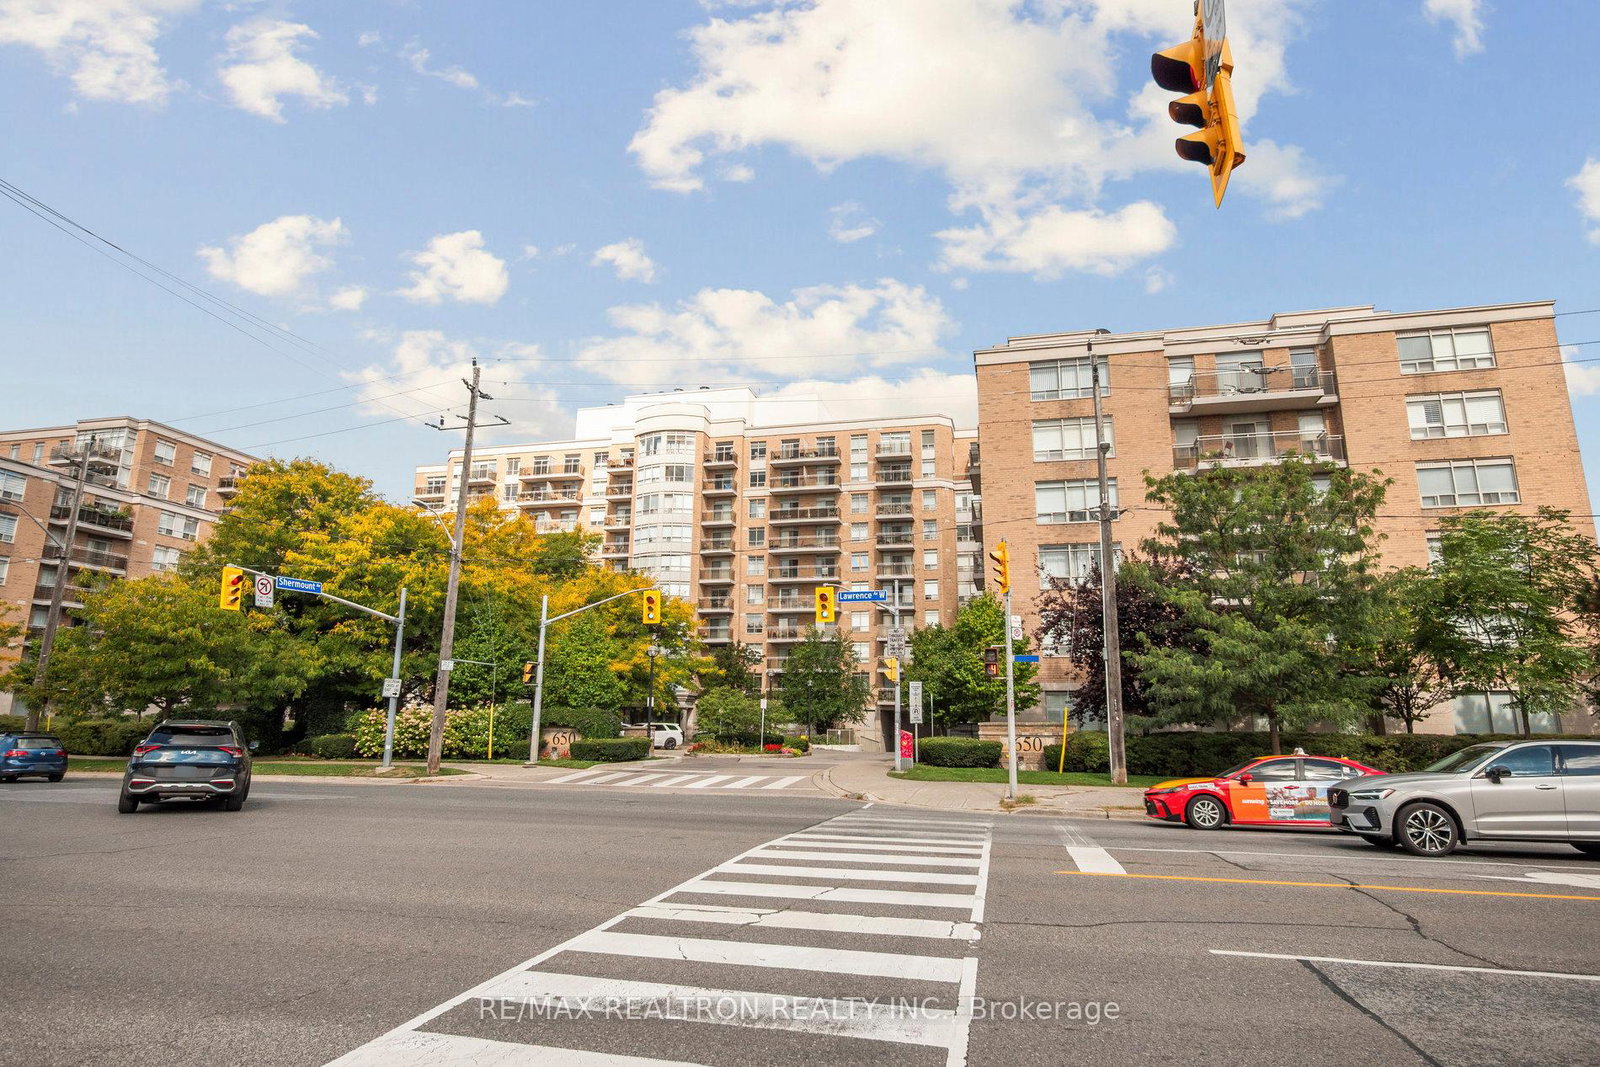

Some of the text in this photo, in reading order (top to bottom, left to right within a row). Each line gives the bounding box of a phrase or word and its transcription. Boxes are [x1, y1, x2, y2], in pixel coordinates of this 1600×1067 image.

[279, 577, 316, 590] Shermount
[840, 592, 872, 600] Lawrence
[552, 731, 576, 745] 650
[1015, 736, 1043, 752] 650
